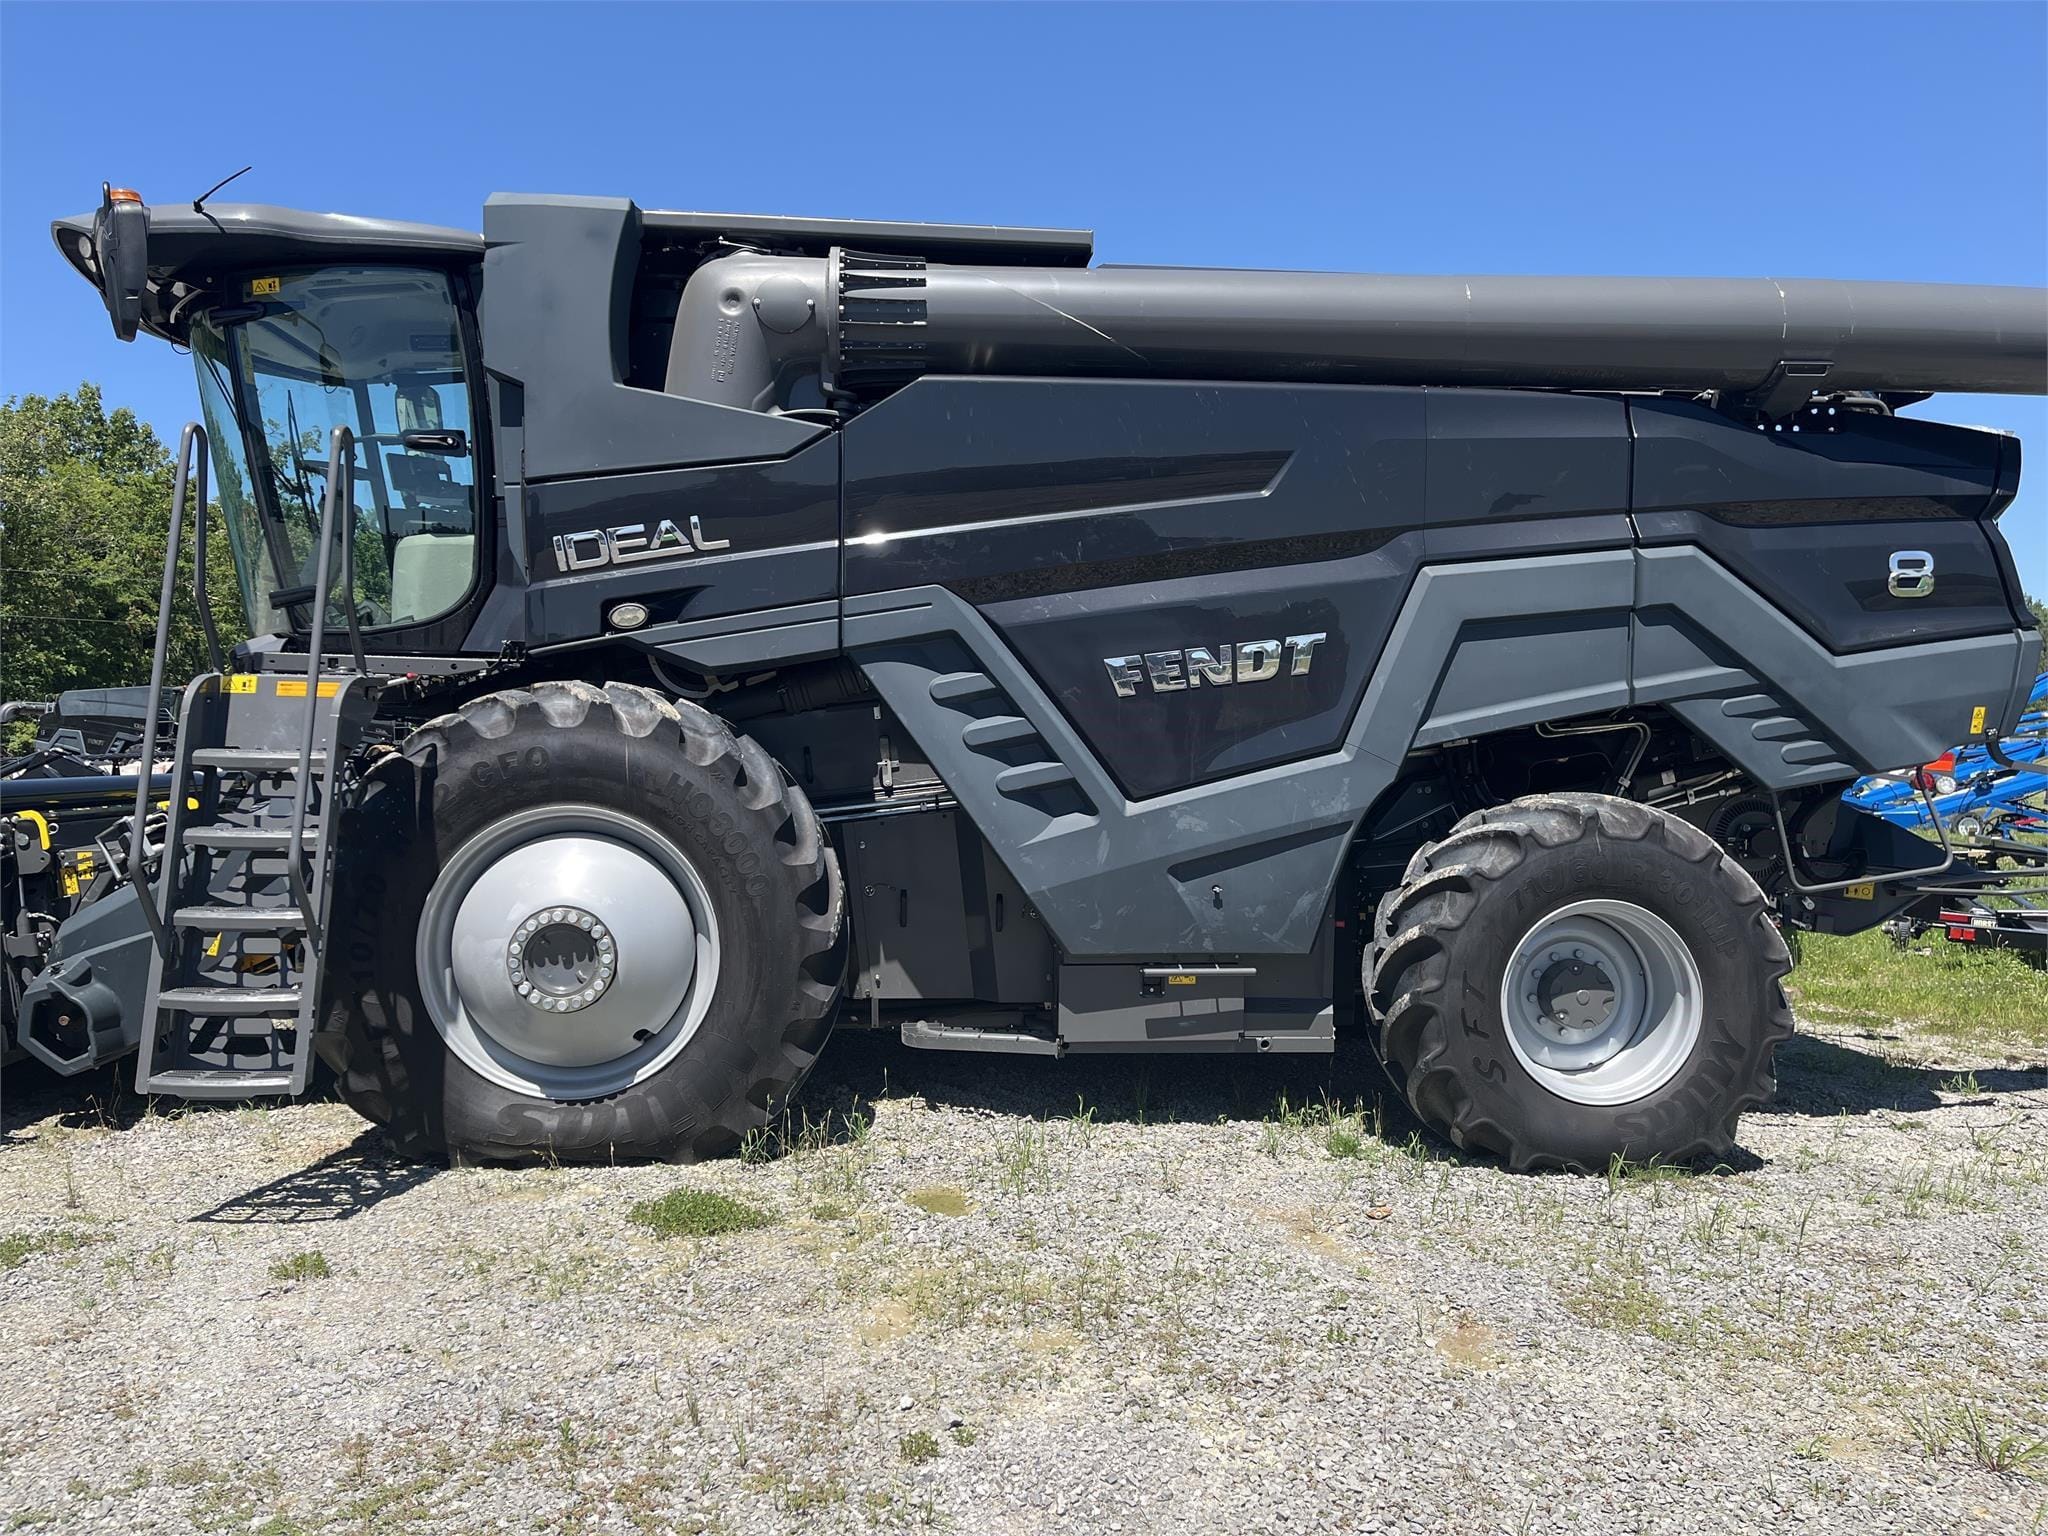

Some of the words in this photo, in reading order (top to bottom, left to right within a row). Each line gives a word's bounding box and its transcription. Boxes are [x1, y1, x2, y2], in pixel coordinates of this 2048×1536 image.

[553, 515, 730, 572] IDEAL
[1888, 551, 1934, 597] 8
[1104, 633, 1326, 697] FENDT
